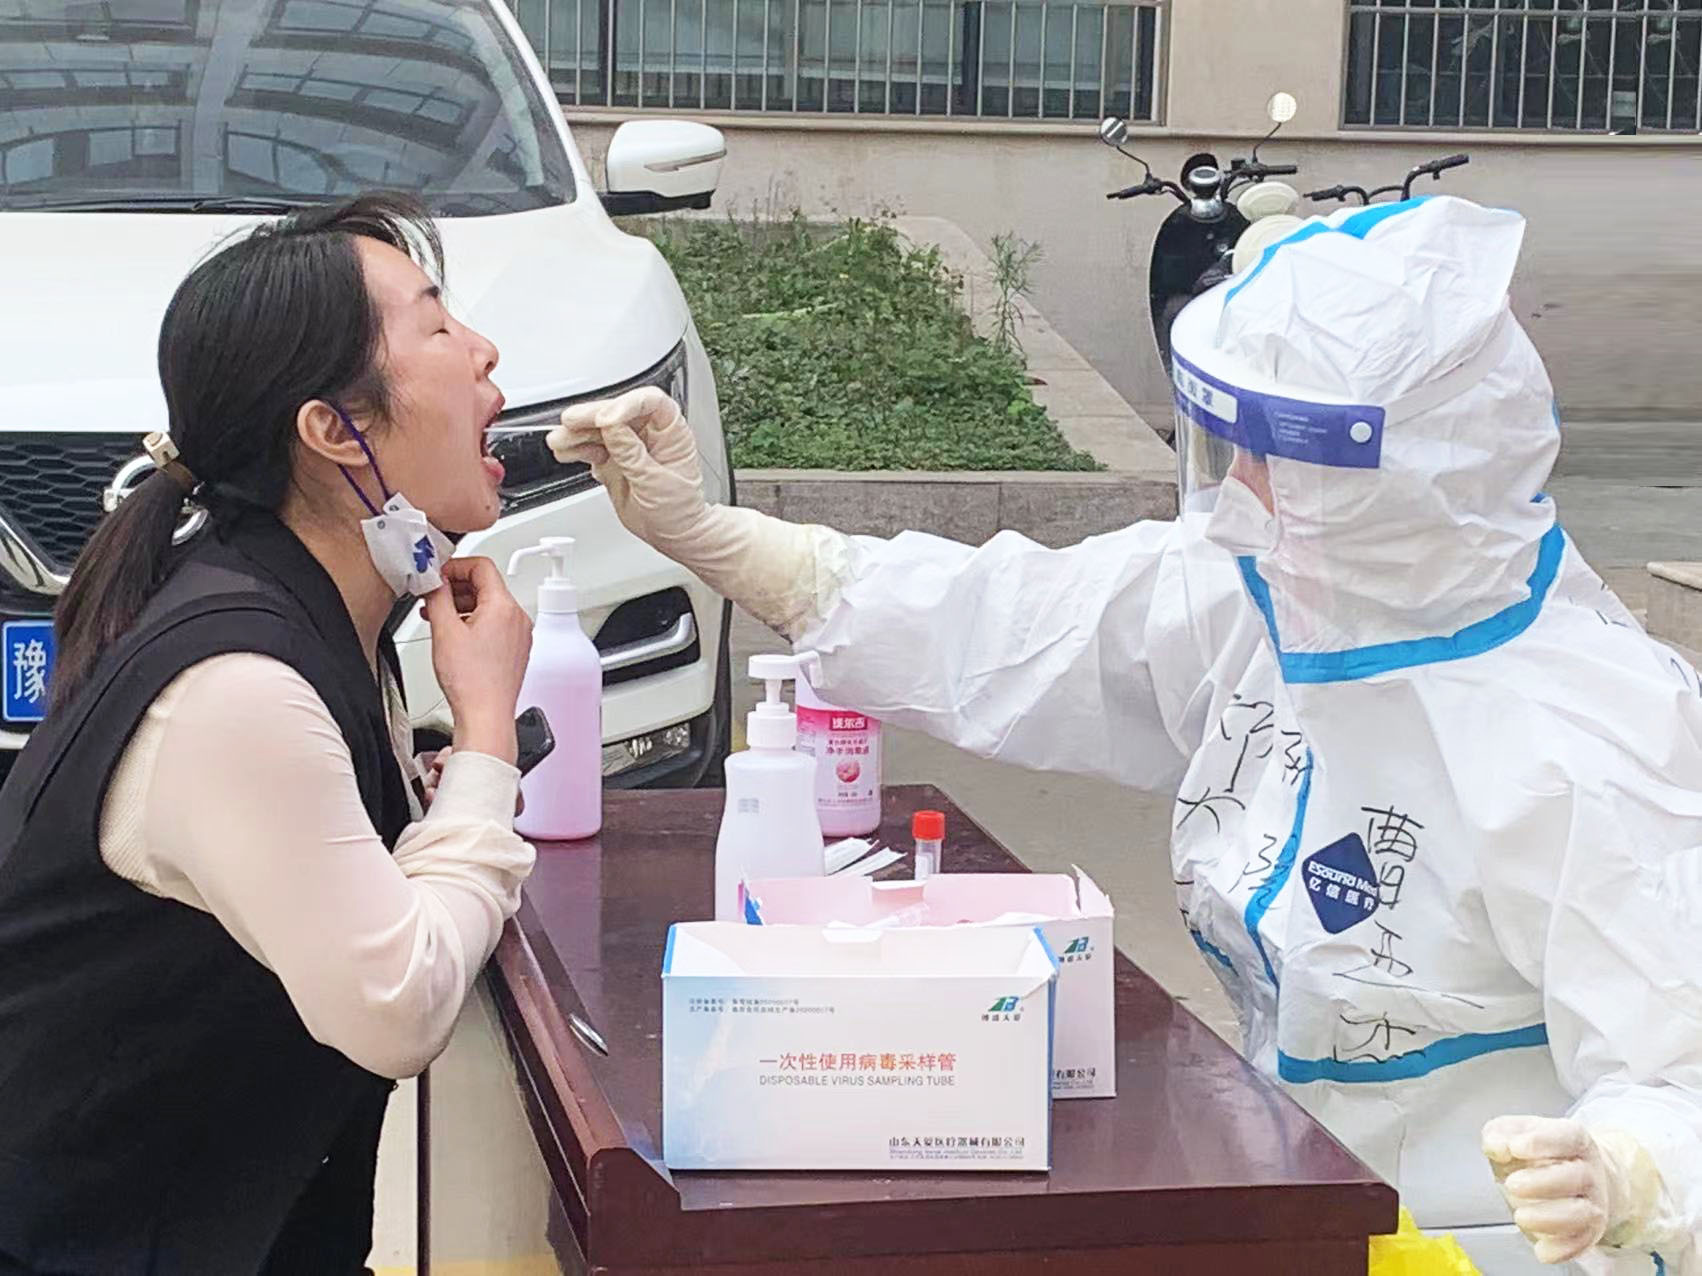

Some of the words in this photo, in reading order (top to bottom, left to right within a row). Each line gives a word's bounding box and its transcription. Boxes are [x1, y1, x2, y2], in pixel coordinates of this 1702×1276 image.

[13, 638, 47, 704] 豫
[759, 1052, 957, 1072] 一次性使用病毒采样管
[759, 1075, 828, 1086] DISPOSABLE
[831, 1075, 865, 1086] VIRUS
[867, 1075, 924, 1086] SAMPLING
[927, 1075, 955, 1086] TUBE
